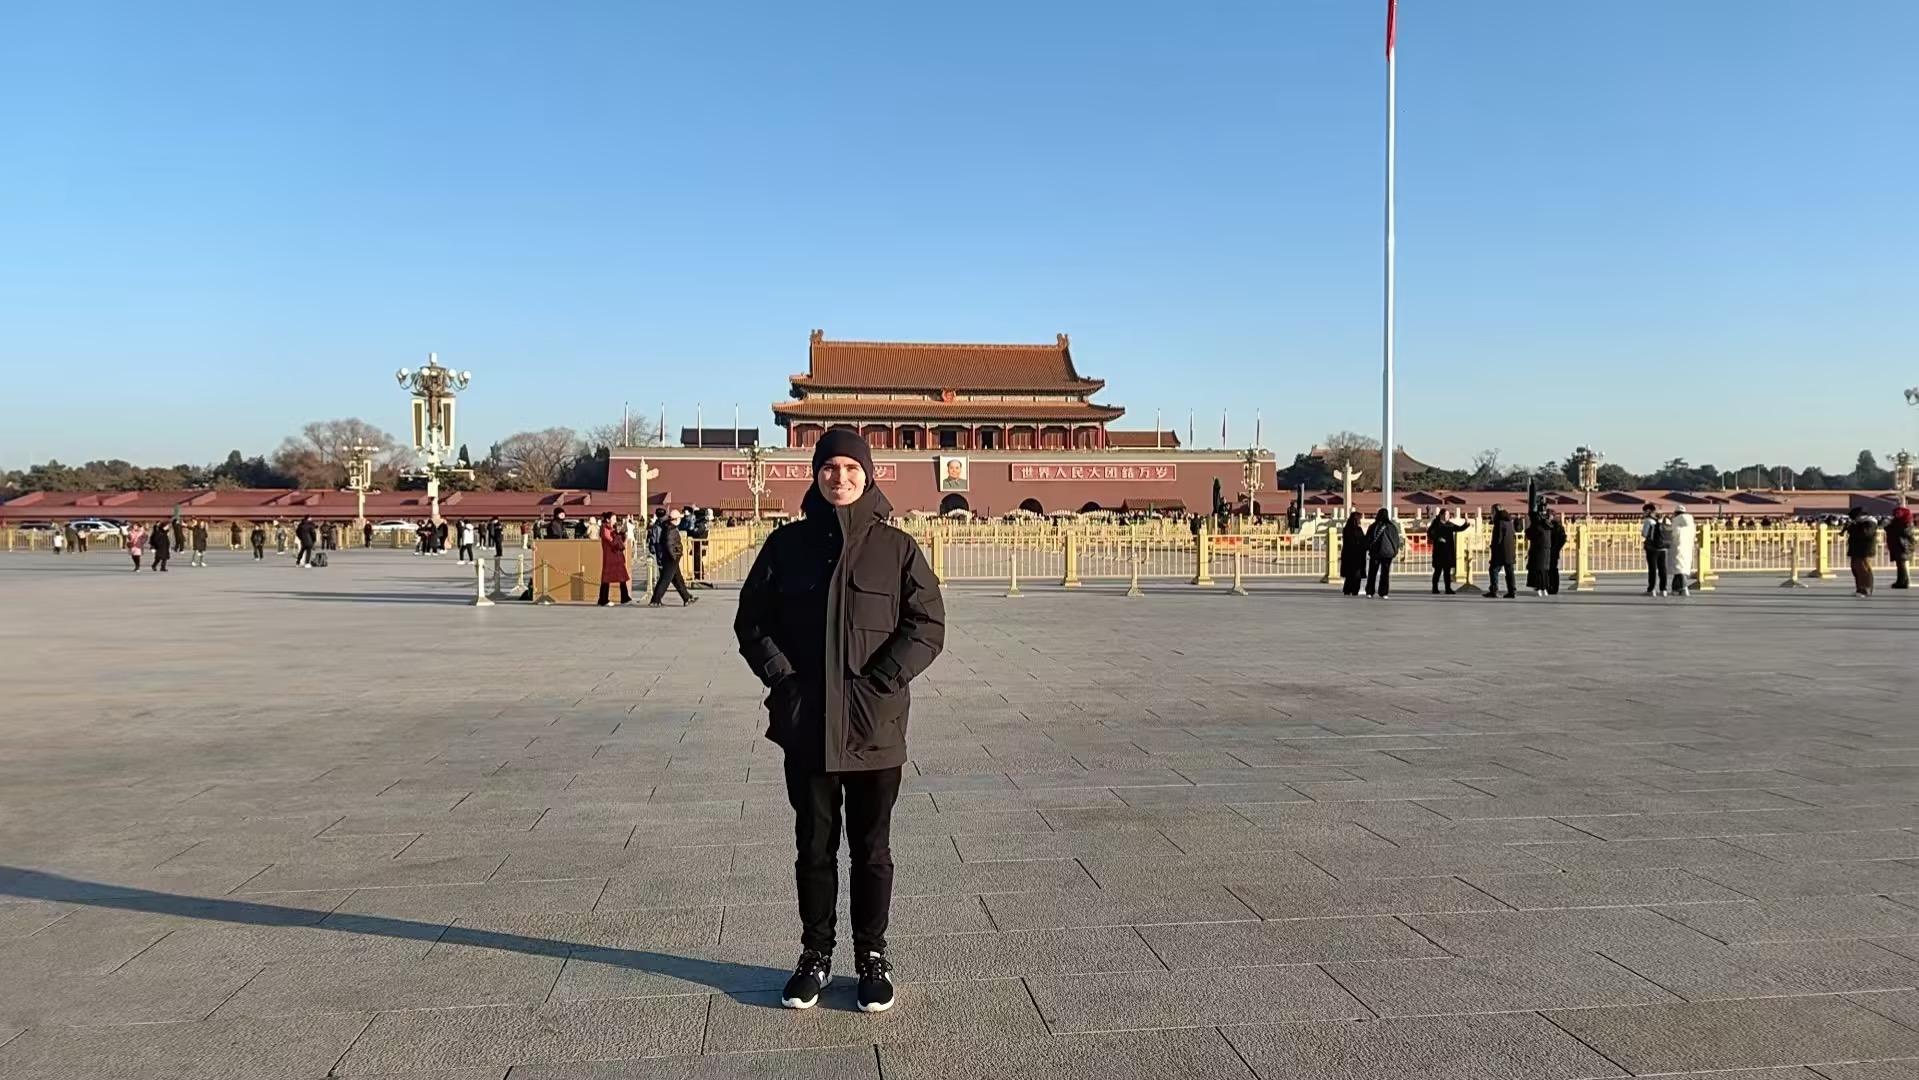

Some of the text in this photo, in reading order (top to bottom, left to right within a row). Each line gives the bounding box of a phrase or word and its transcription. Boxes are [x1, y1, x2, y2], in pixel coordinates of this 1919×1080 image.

[1021, 466, 1168, 479] 世界人民大团结万岁
